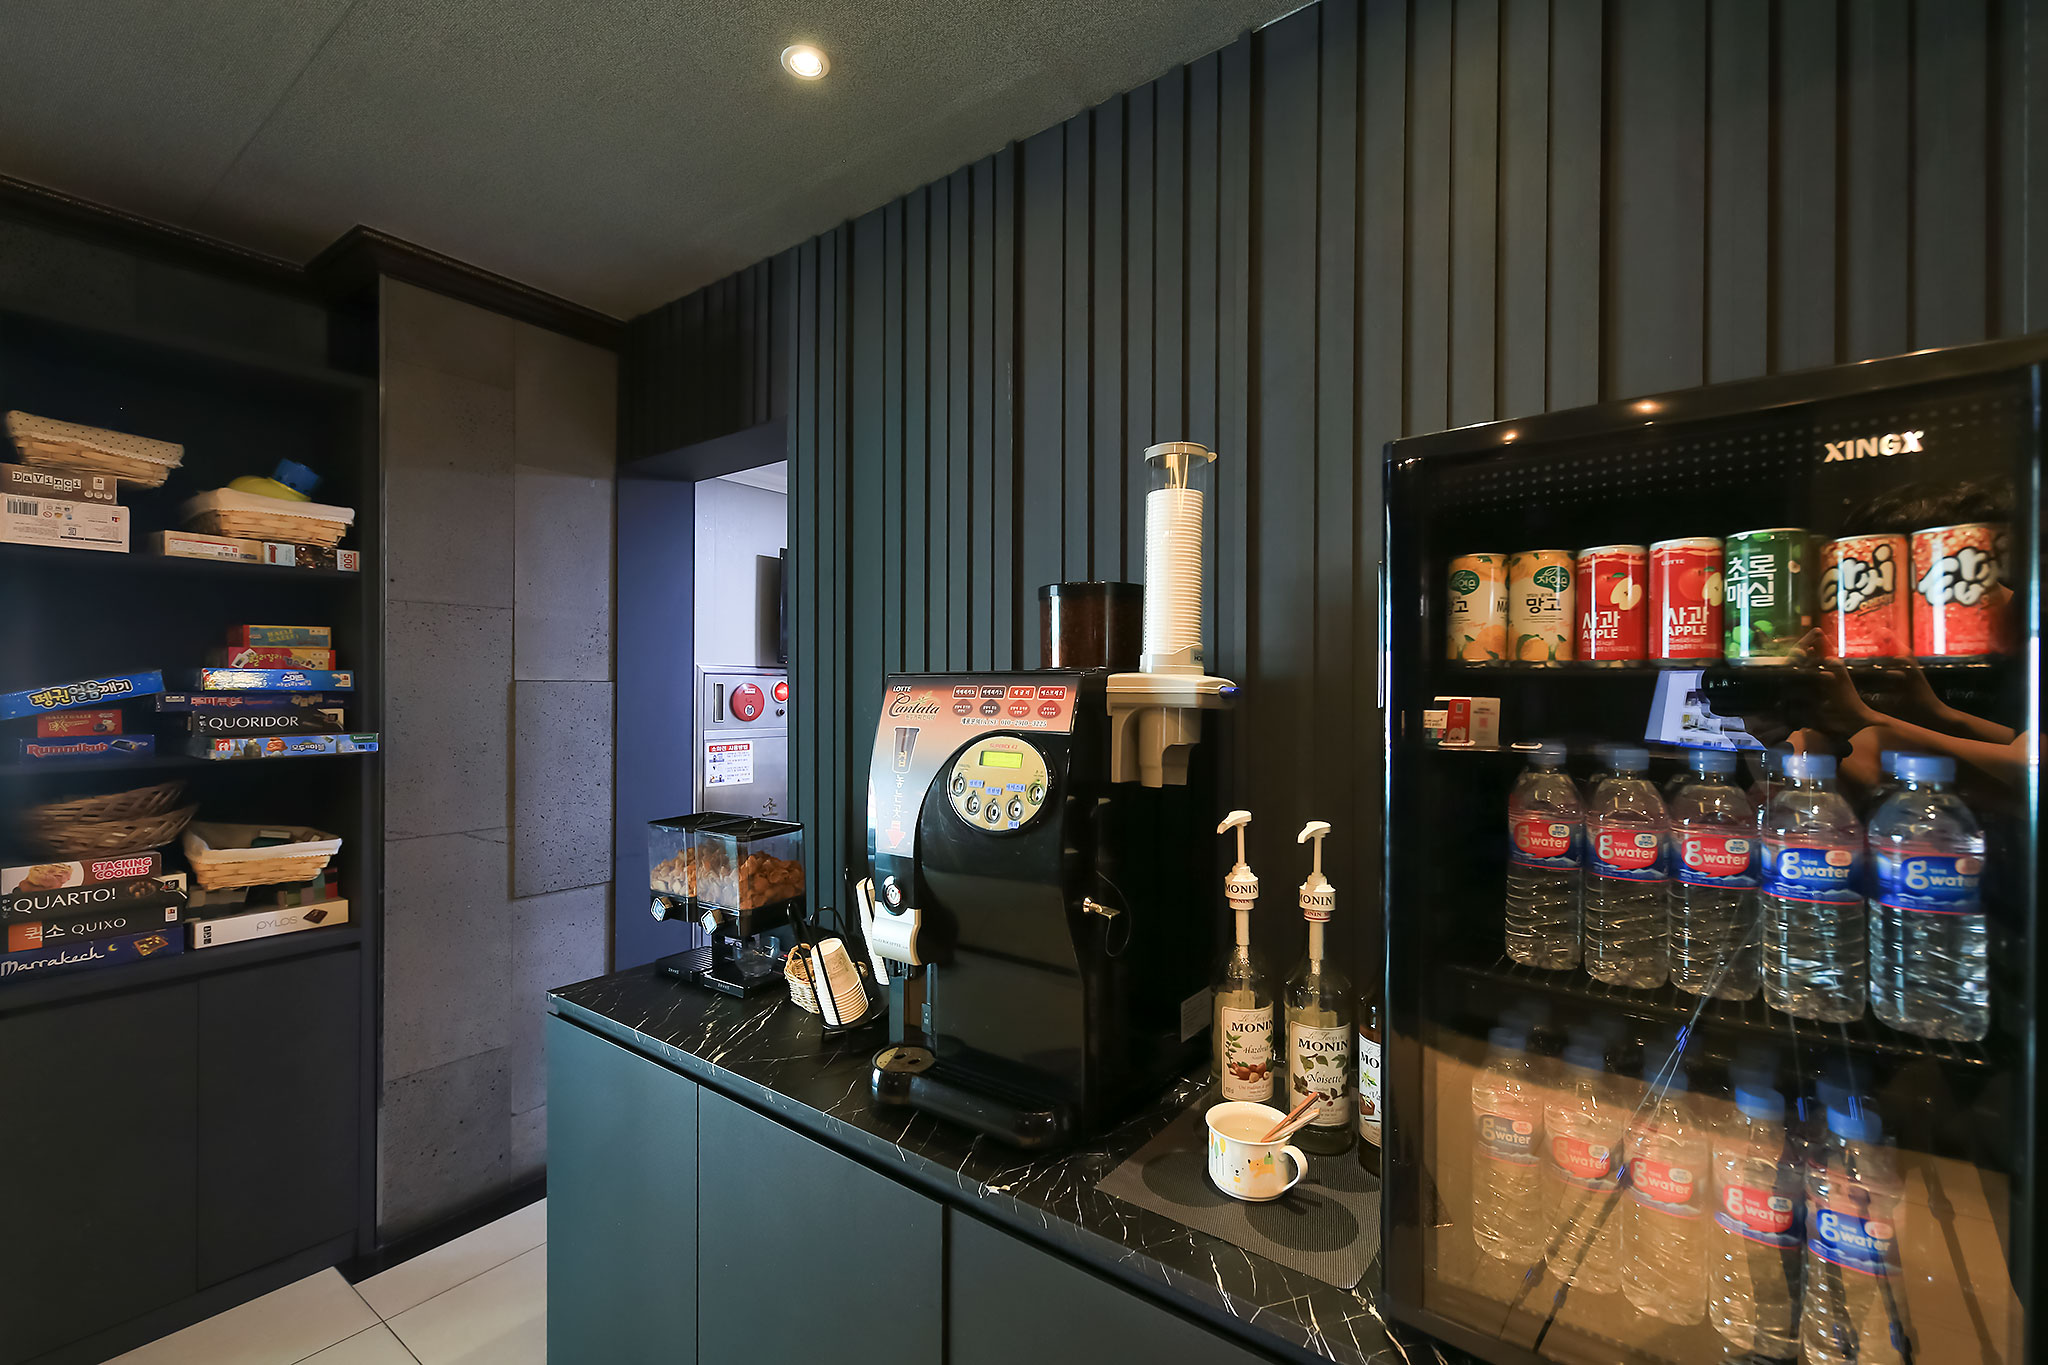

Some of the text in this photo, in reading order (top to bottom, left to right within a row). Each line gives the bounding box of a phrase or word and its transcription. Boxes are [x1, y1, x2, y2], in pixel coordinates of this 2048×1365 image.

[1824, 431, 1925, 463] XINGX
[13, 472, 81, 489] DaVinci
[1727, 554, 1777, 581] 초록
[1536, 575, 1568, 588] 자연은
[1727, 581, 1775, 608] 매실
[1526, 598, 1562, 614] 망고
[1583, 611, 1620, 629] 사과
[1669, 607, 1710, 625] 사과
[1583, 629, 1618, 639] APLE
[1668, 625, 1707, 636] APPLE
[889, 693, 940, 717] Cantata
[208, 716, 299, 731] QUORIDOR
[27, 742, 108, 758] Rummikub
[1530, 837, 1568, 848] water
[1614, 848, 1655, 859] water
[1703, 854, 1747, 865] water
[91, 857, 152, 873] STACKING
[94, 865, 151, 880] COOKIES
[1801, 866, 1850, 878] water
[13, 888, 117, 914] QUARTO!
[24, 918, 127, 942] 퀵소 QUIXO
[256, 916, 298, 932] PYLOS
[1, 946, 105, 977] Marrakech
[1231, 1020, 1273, 1033] MONIN
[1298, 1038, 1348, 1051] MONIN
[1306, 1072, 1342, 1084] Noisette
[1495, 1131, 1531, 1144] water
[1569, 1154, 1608, 1169] water
[1648, 1176, 1690, 1194] water
[1744, 1204, 1791, 1224] water
[1840, 1231, 1891, 1251] water
